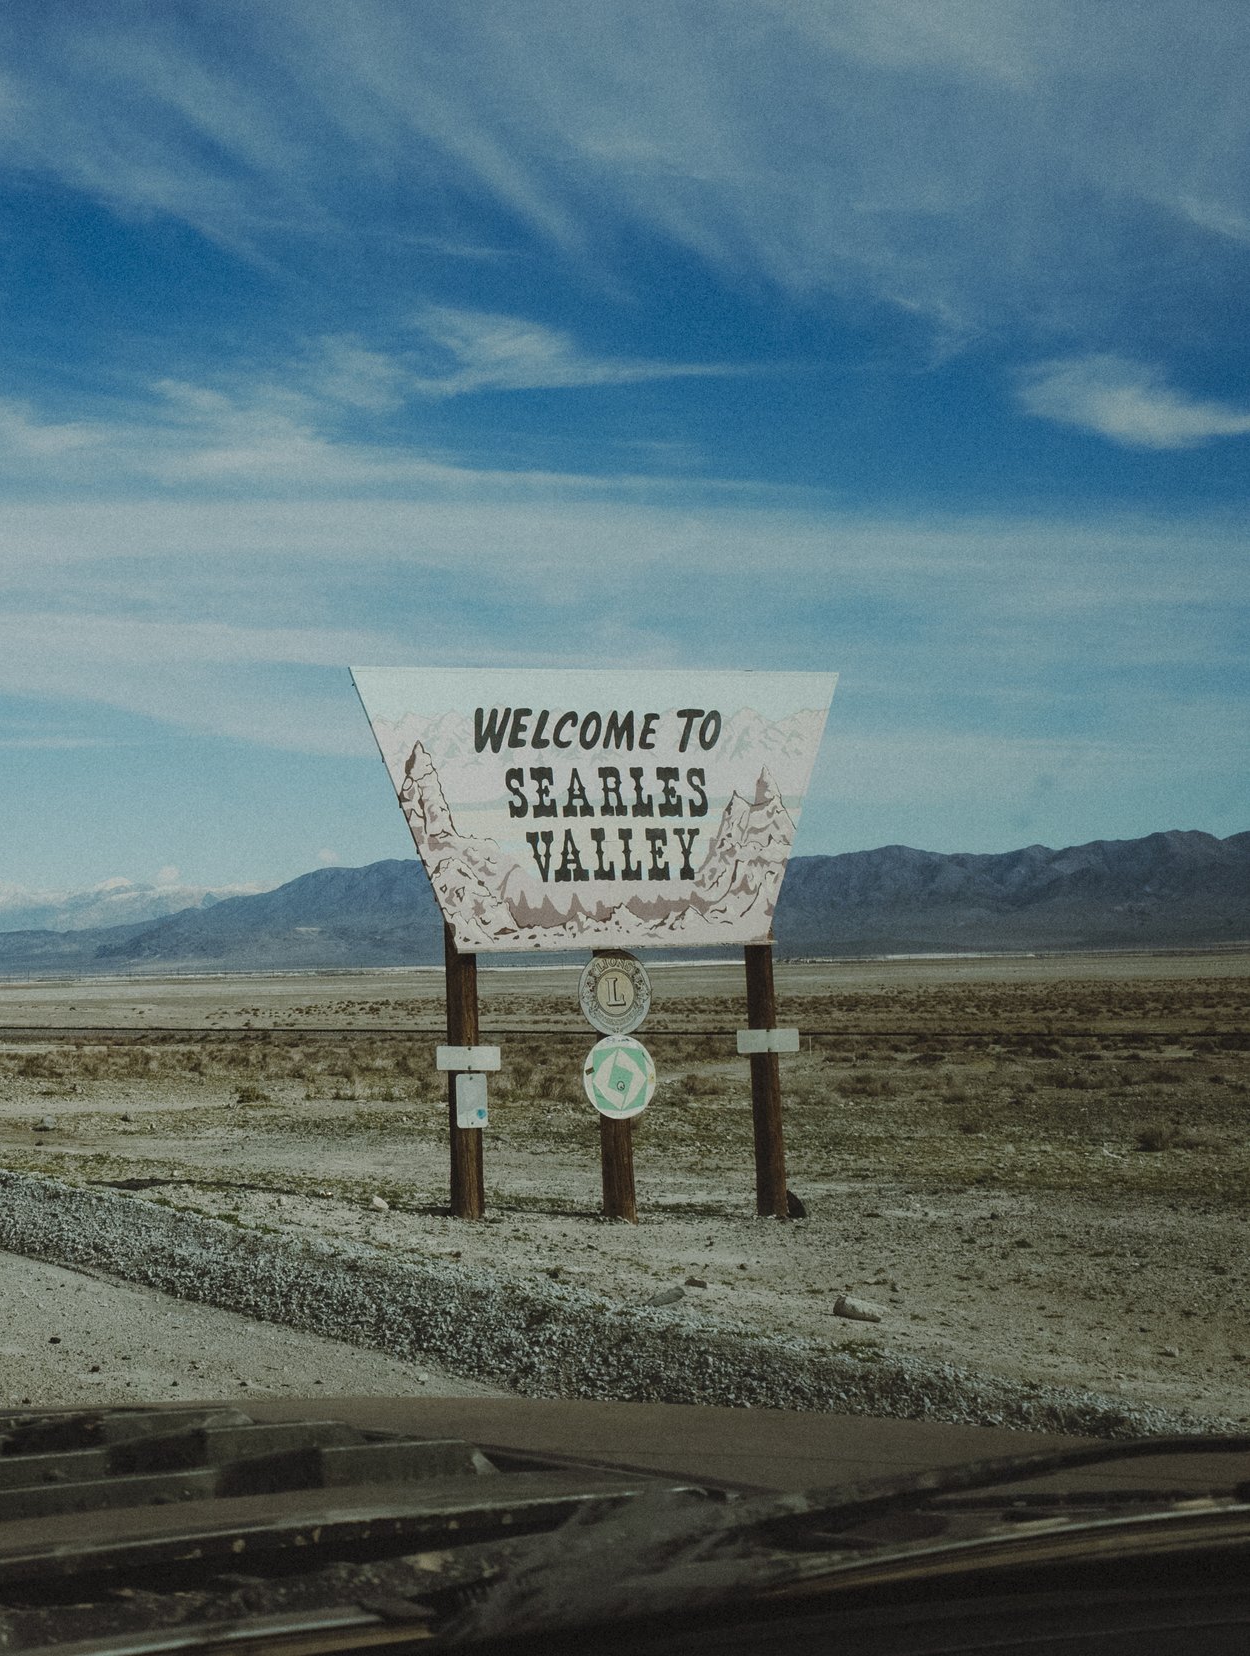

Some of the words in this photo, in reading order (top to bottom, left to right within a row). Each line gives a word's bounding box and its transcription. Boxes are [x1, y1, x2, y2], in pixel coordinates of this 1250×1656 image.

[474, 707, 661, 753] WELCOME
[676, 709, 721, 753] TO
[505, 766, 709, 818] SEARLES
[526, 828, 700, 883] VALLEY
[595, 958, 634, 974] LIONS
[606, 977, 626, 1007] L
